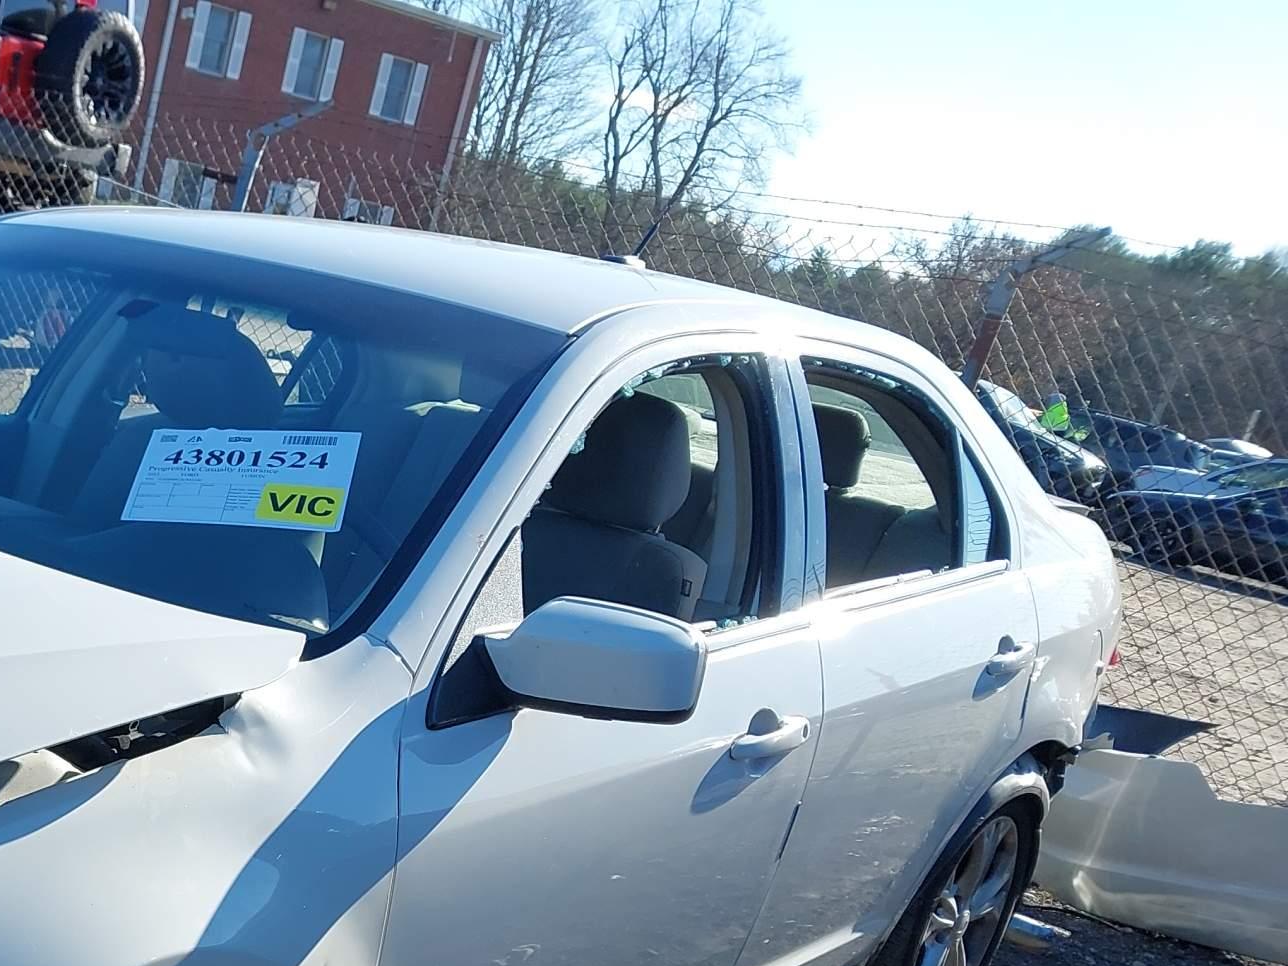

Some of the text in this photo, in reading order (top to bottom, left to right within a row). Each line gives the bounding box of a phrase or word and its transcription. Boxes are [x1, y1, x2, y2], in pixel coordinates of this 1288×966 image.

[148, 465, 279, 475] Progressive Casualty Insurance
[164, 448, 329, 470] 43801524
[268, 491, 335, 517] VIC
